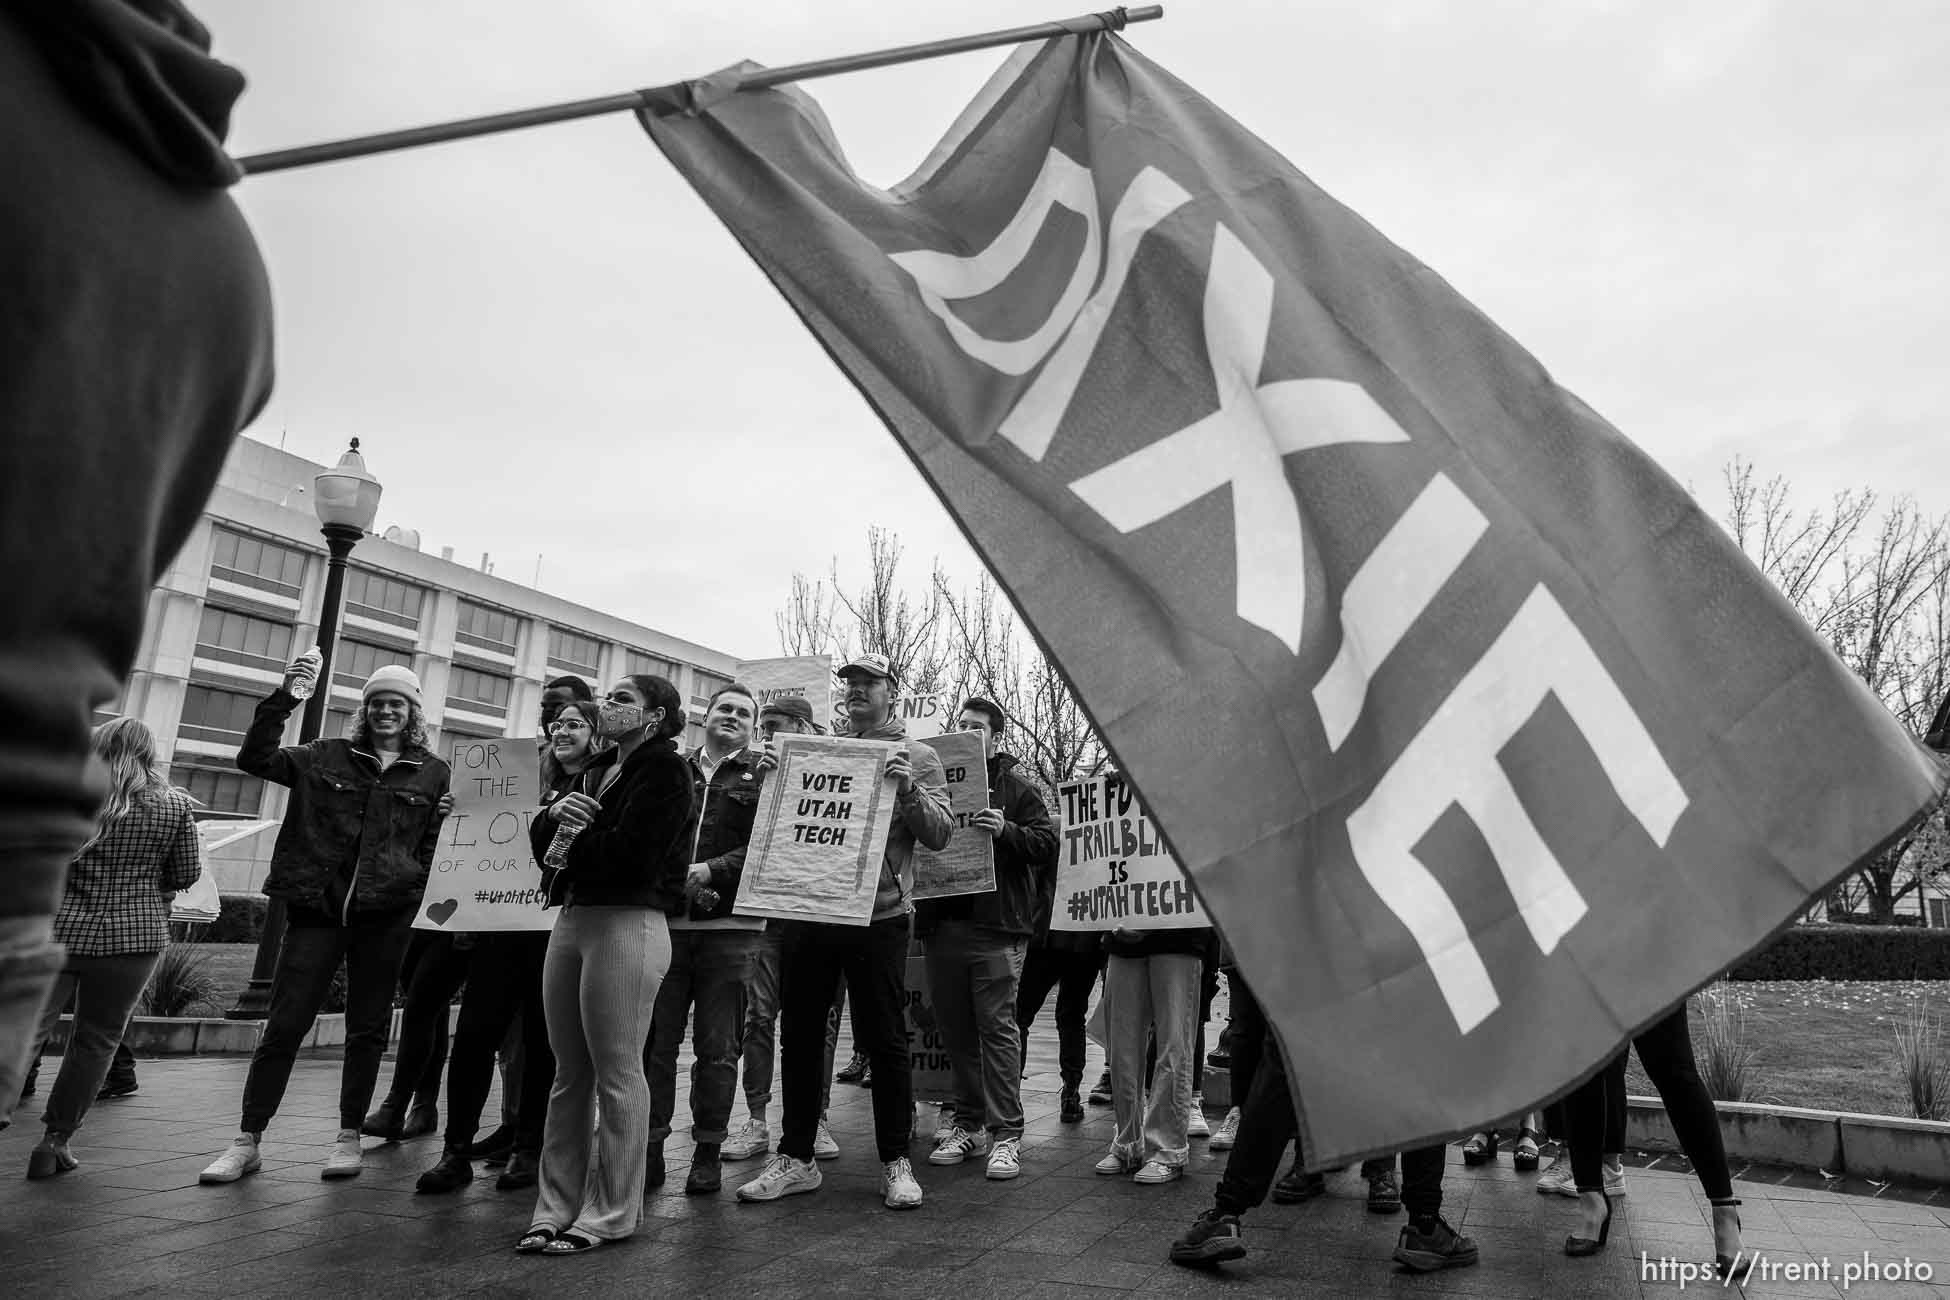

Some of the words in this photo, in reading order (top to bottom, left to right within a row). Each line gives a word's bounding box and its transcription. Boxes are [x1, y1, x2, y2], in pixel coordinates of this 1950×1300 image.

[888, 146, 1691, 1036] DIXIE
[453, 744, 503, 770] FOR
[472, 775, 519, 797] THE
[802, 772, 853, 793] VOTE
[797, 798, 853, 820] UTAH
[1060, 783, 1098, 826] THE
[1104, 779, 1147, 819] FU
[794, 824, 846, 846] TECH
[438, 859, 465, 873] OF
[477, 858, 520, 872] OUR
[1109, 861, 1129, 885] IS
[1067, 880, 1195, 921] #UTAHTECH
